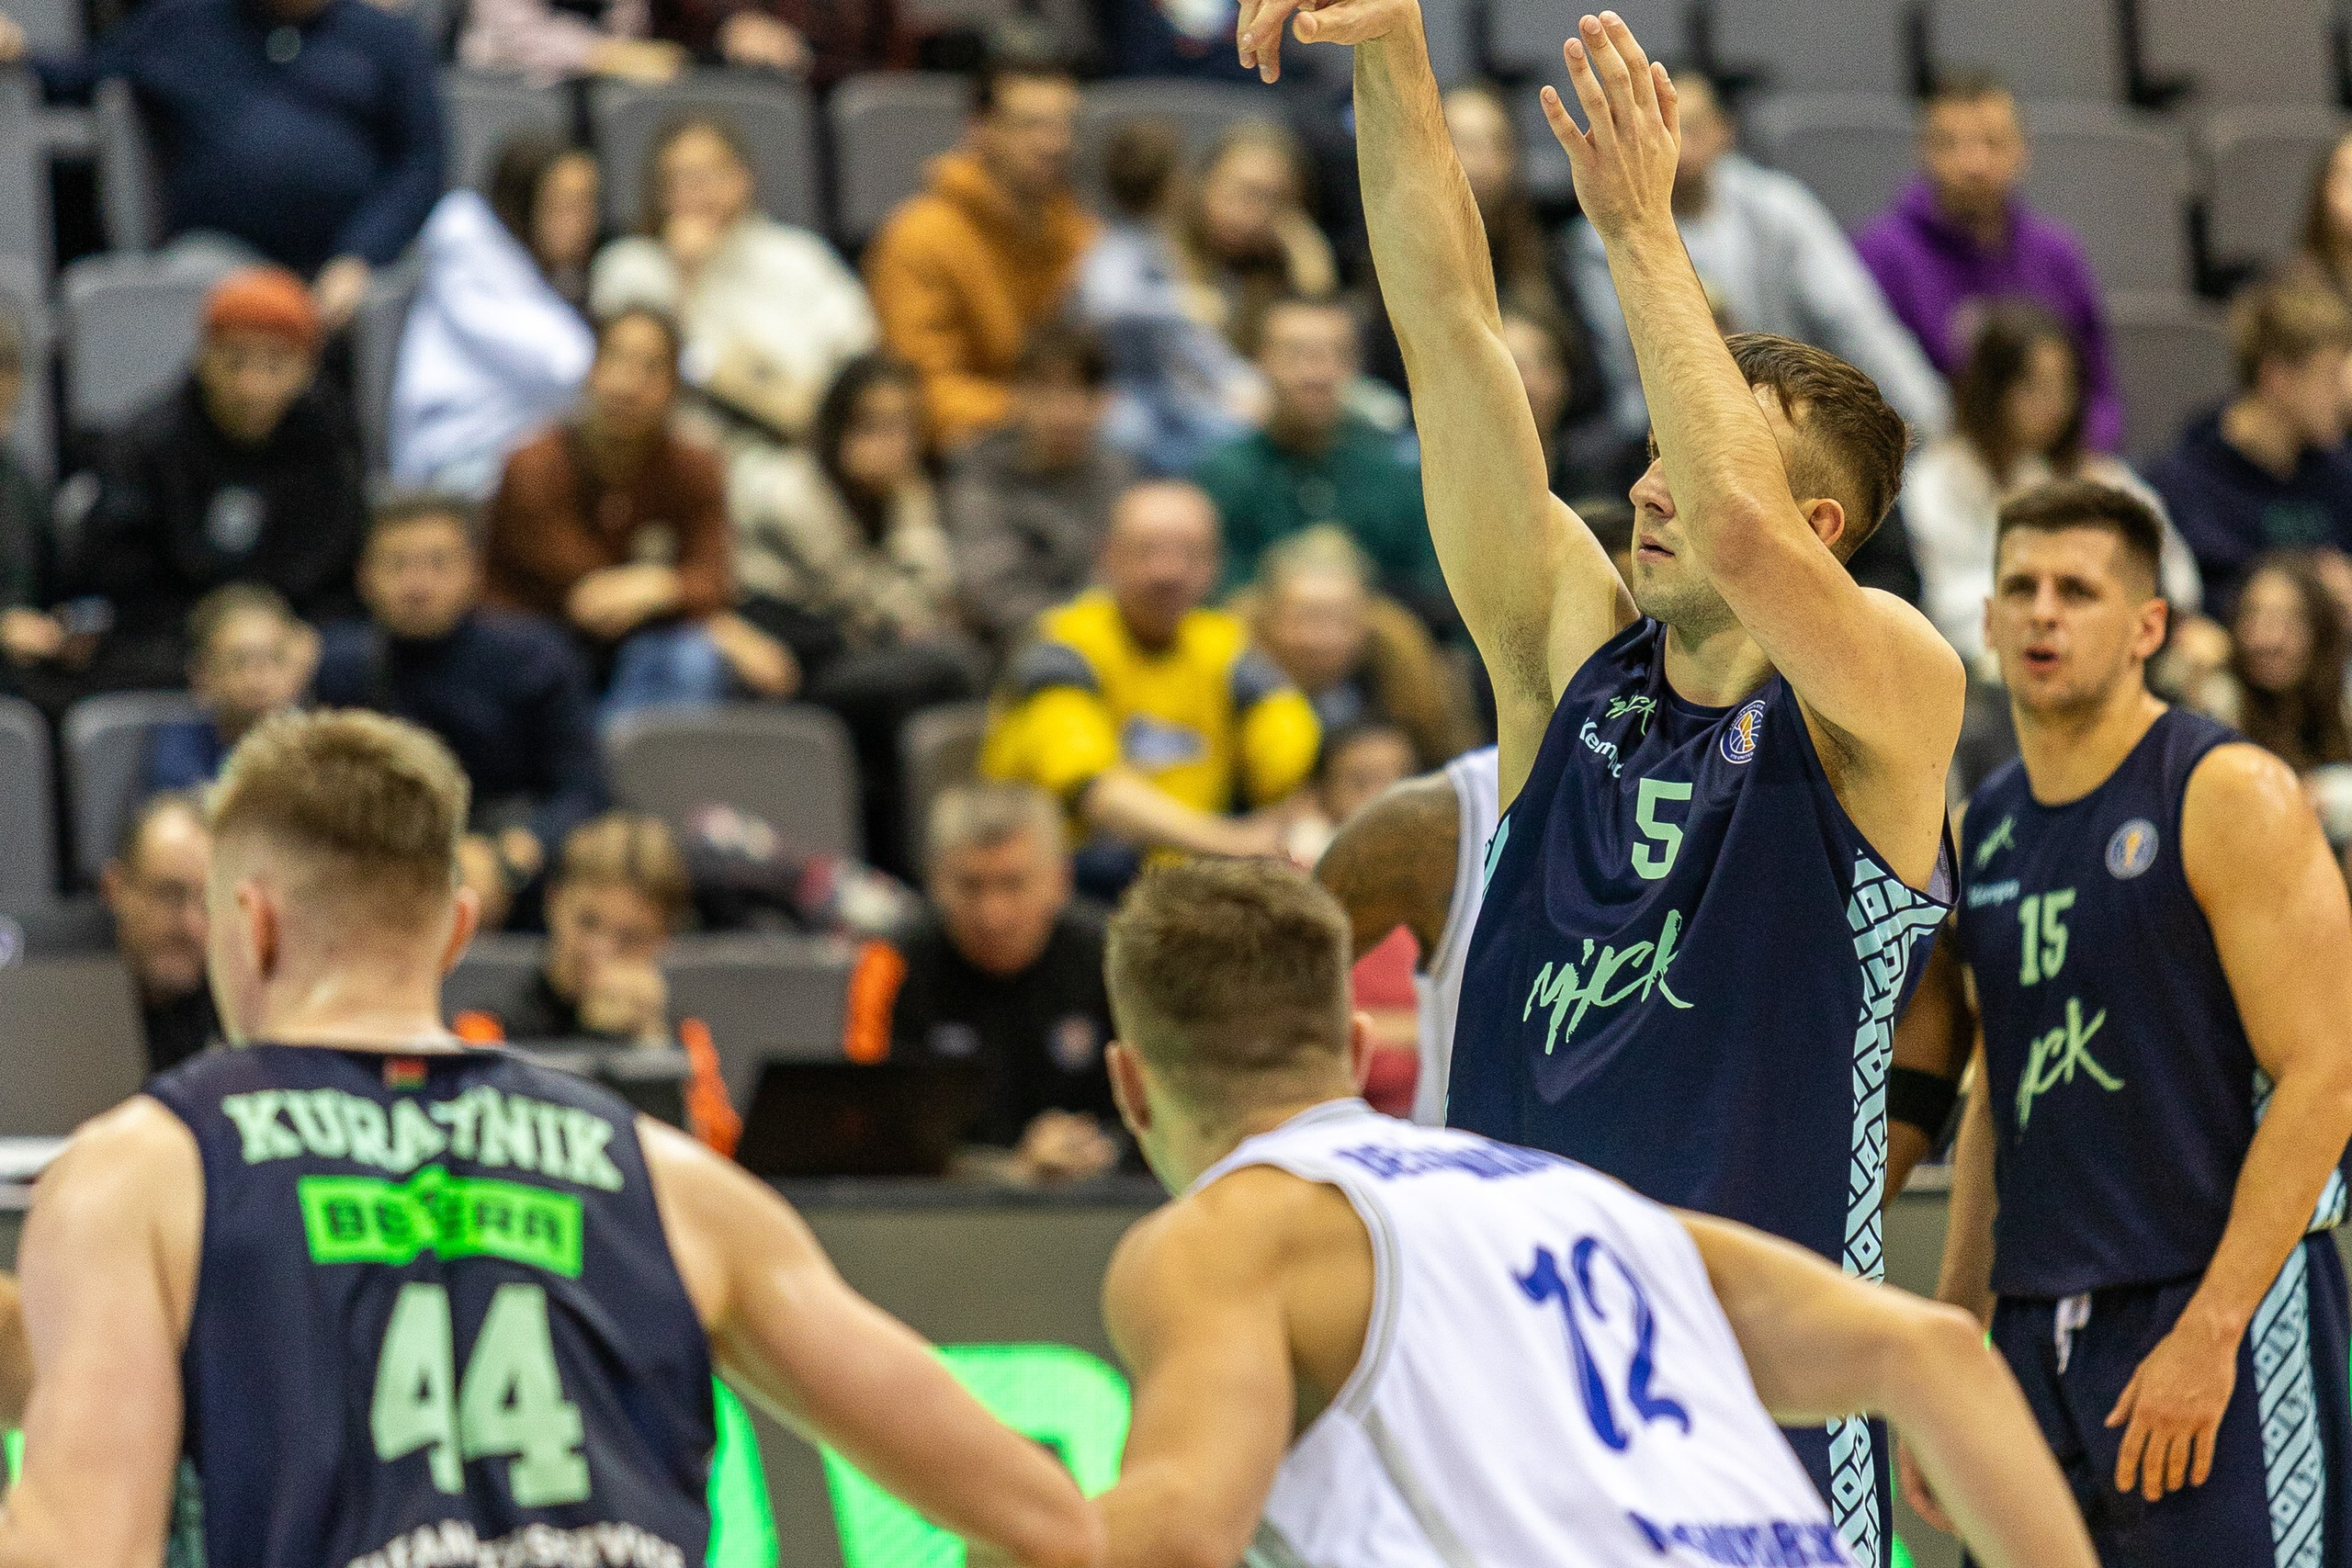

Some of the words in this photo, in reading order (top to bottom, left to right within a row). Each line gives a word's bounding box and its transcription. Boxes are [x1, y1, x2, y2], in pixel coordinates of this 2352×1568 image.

[1632, 777, 1693, 880] 5
[2018, 886, 2076, 987] 15
[370, 1281, 592, 1506] 44
[1511, 1235, 1691, 1453] 12
